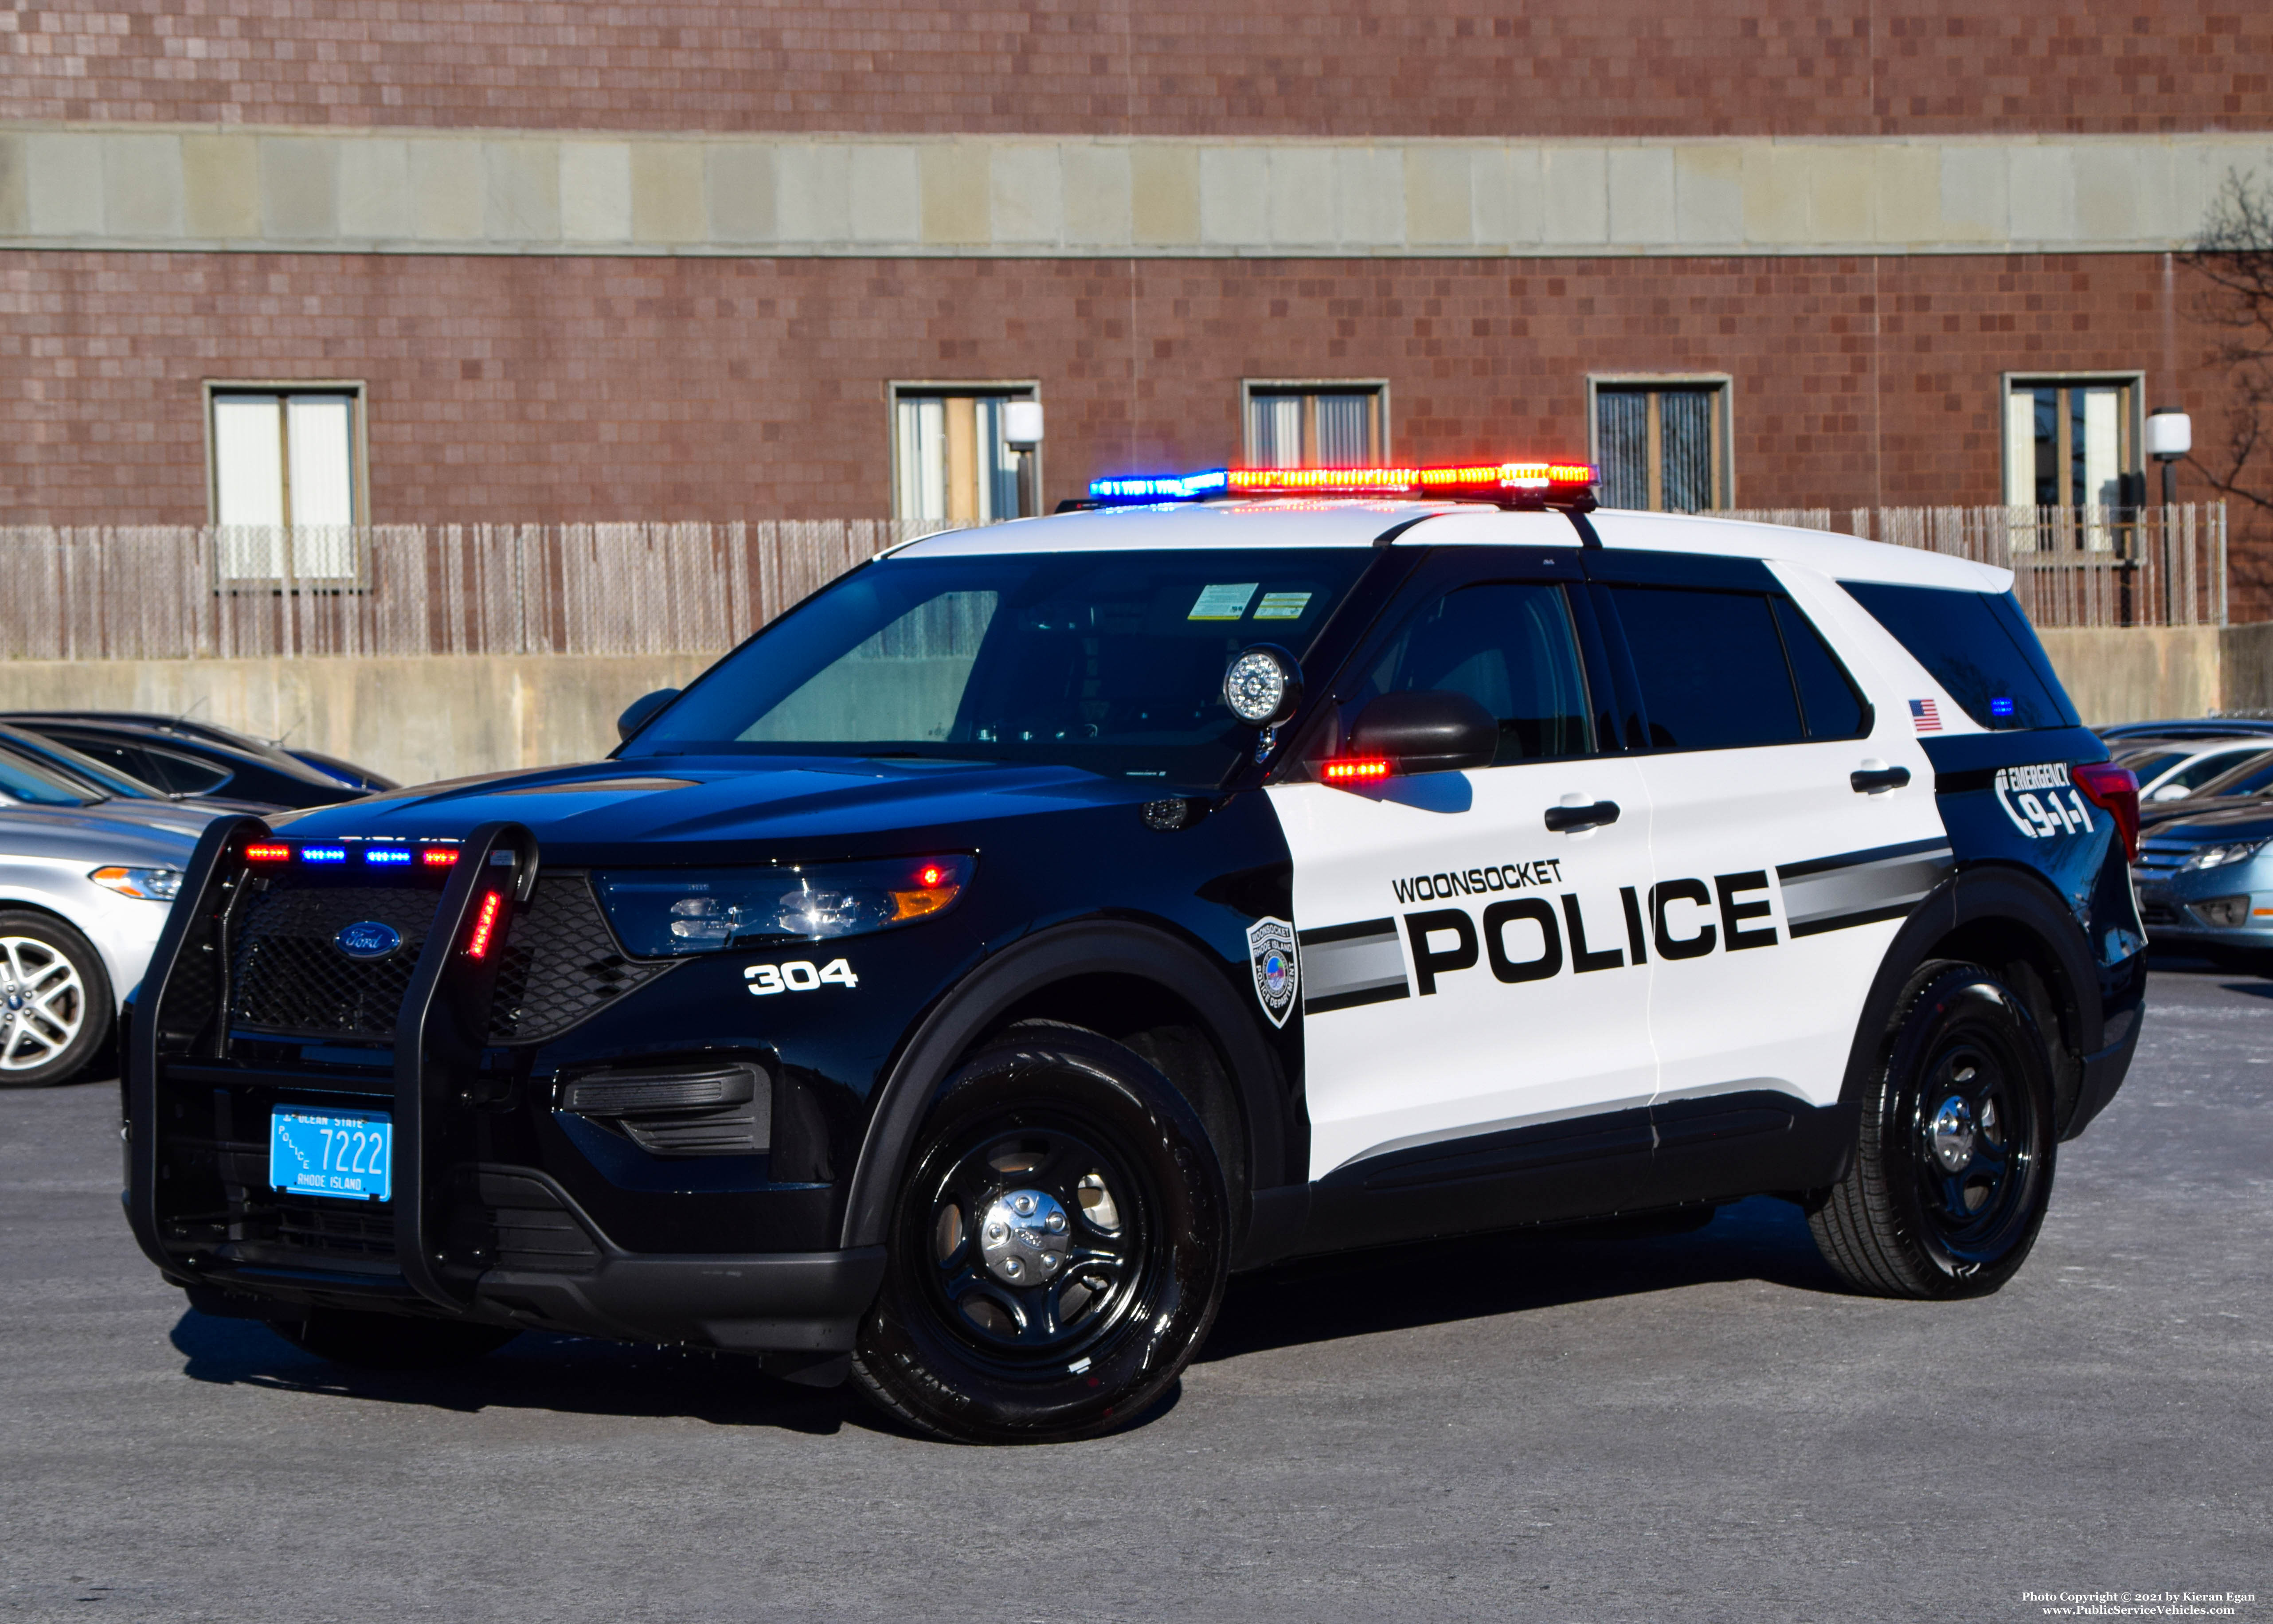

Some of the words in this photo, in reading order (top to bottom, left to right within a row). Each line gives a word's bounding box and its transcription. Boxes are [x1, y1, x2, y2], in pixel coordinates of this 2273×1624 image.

[2008, 763, 2070, 792] EMERGENCY
[2018, 789, 2094, 837] 9-1-1
[1392, 858, 1561, 904] WOONSOCKET
[346, 928, 383, 948] Ford
[1252, 924, 1289, 943] WOONSOCKET
[1253, 942, 1271, 957] RHODE
[1271, 940, 1292, 953] ISLAND
[1404, 870, 1778, 996] POLICE
[744, 959, 859, 995] 304
[1256, 965, 1271, 1003] POLICE
[1270, 961, 1295, 1009] DEPARTMENT
[298, 1115, 328, 1126] OCEAN
[334, 1117, 364, 1129] STATE
[278, 1125, 309, 1169] POLICE
[320, 1129, 383, 1174] 7222
[297, 1173, 325, 1187] RHODE
[330, 1176, 361, 1190] ISLAND
